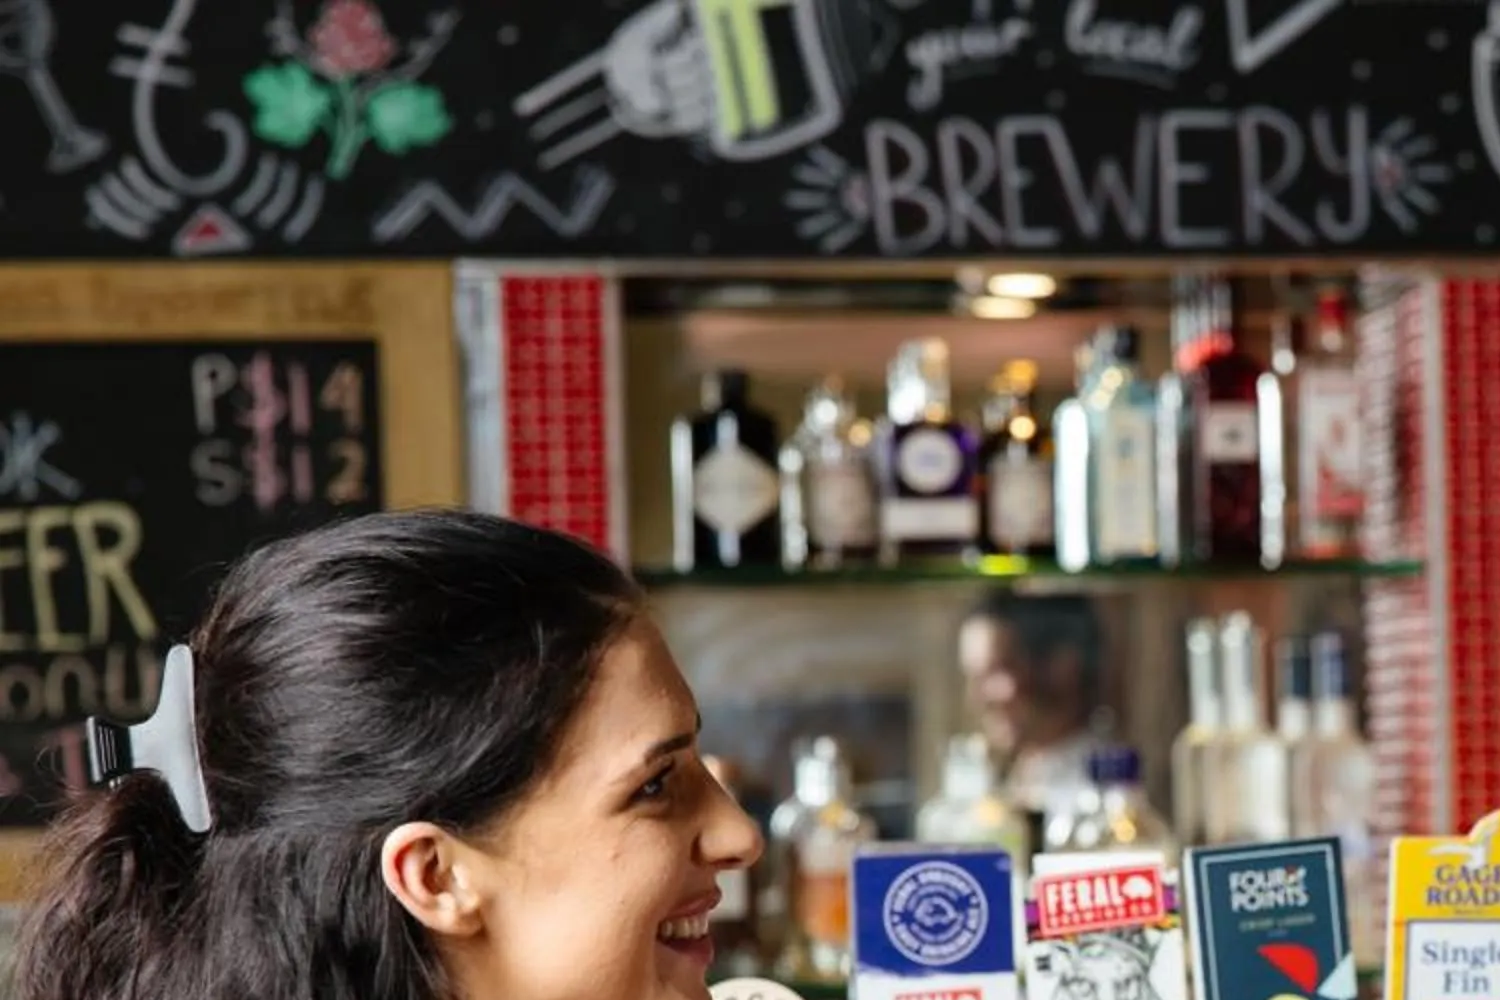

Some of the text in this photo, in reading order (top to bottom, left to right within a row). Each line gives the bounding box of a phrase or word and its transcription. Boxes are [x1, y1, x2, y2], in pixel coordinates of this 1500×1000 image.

[1064, 0, 1203, 70] local
[865, 105, 1372, 255] BREWERY
[1045, 873, 1126, 916] FERAL
[1231, 886, 1311, 912] POINTS
[1442, 970, 1491, 994] Fin
